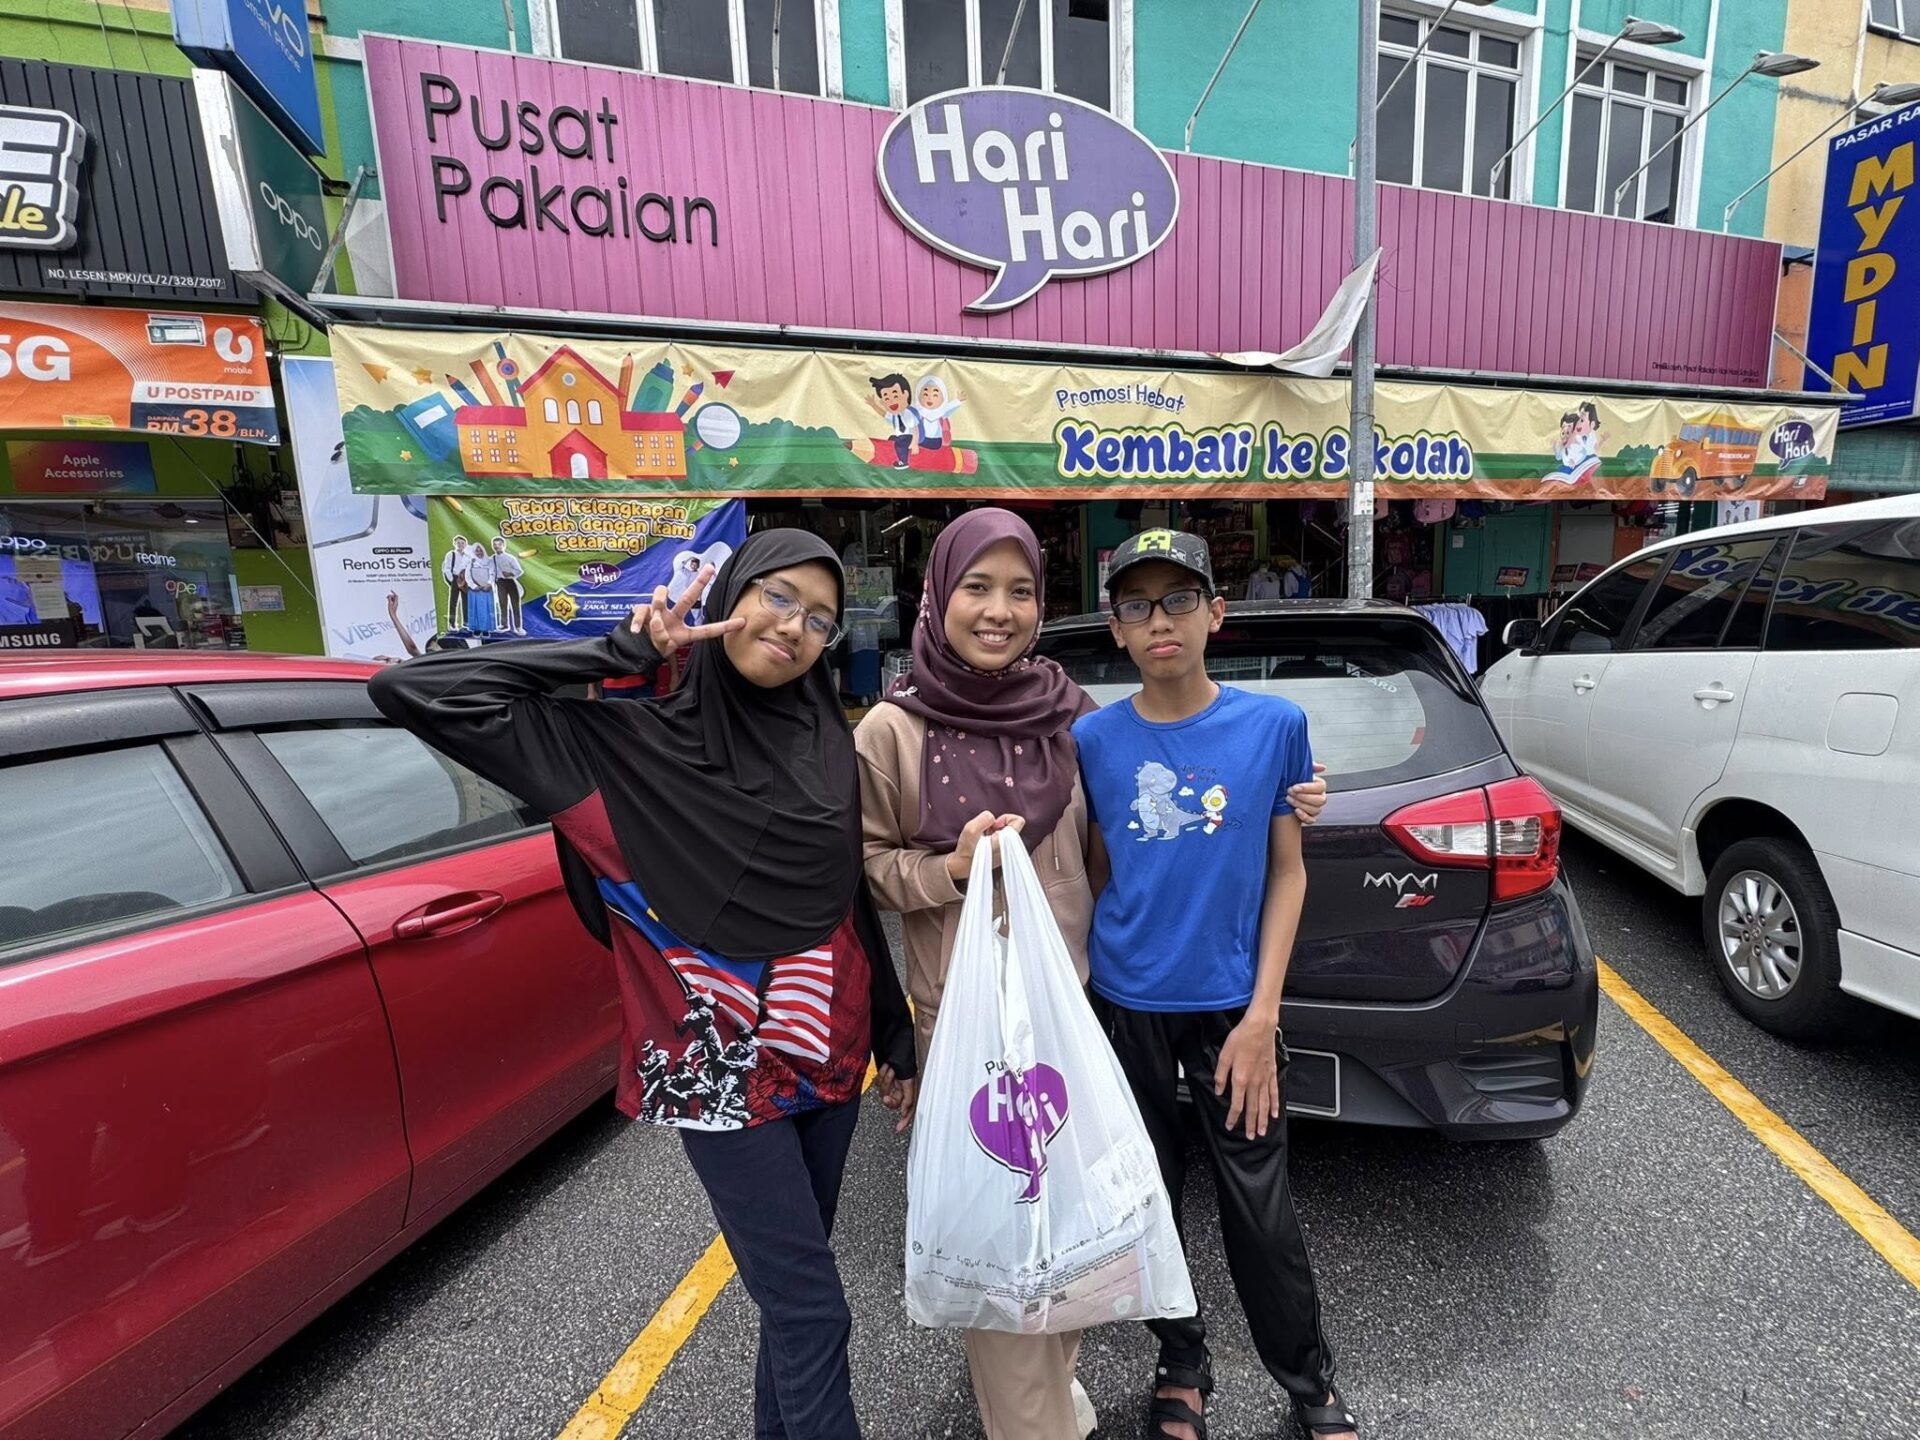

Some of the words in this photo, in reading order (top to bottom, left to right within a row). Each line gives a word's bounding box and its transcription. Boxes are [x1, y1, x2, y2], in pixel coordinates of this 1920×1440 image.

[420, 73, 617, 162] Pusat
[910, 104, 1068, 183] Hari
[1835, 118, 1892, 150] PASAR
[431, 155, 718, 246] Pakaian
[260, 182, 321, 250] oppo
[1003, 187, 1149, 261] Hari
[49, 269, 66, 279] NO.
[69, 270, 107, 281] LESEN:
[1831, 141, 1914, 393] MYDIN
[223, 366, 253, 375] mobile
[147, 387, 160, 398] U
[1056, 384, 1131, 411] Promosi
[1135, 385, 1186, 412] Hebat
[181, 408, 237, 438] 38
[1774, 425, 1801, 444] Hari
[1060, 425, 1253, 474] Kembali
[1267, 429, 1313, 474] ke
[1323, 431, 1473, 476] Skolah
[1785, 441, 1810, 459] Hari
[63, 455, 100, 467] Apple
[44, 468, 125, 478] Accessories
[505, 500, 567, 516] Tebus
[570, 499, 688, 520] kelengkapan
[502, 518, 577, 536] sekolah
[579, 518, 649, 536] dengan
[652, 520, 695, 538] kami
[556, 536, 647, 554] sekarang!
[136, 551, 176, 567] realme
[343, 558, 395, 570] Reno15
[580, 565, 604, 576] Hari
[594, 571, 617, 584] Hari
[165, 579, 208, 598] open
[582, 603, 608, 611] ZAKAT
[332, 623, 381, 646] VIBE
